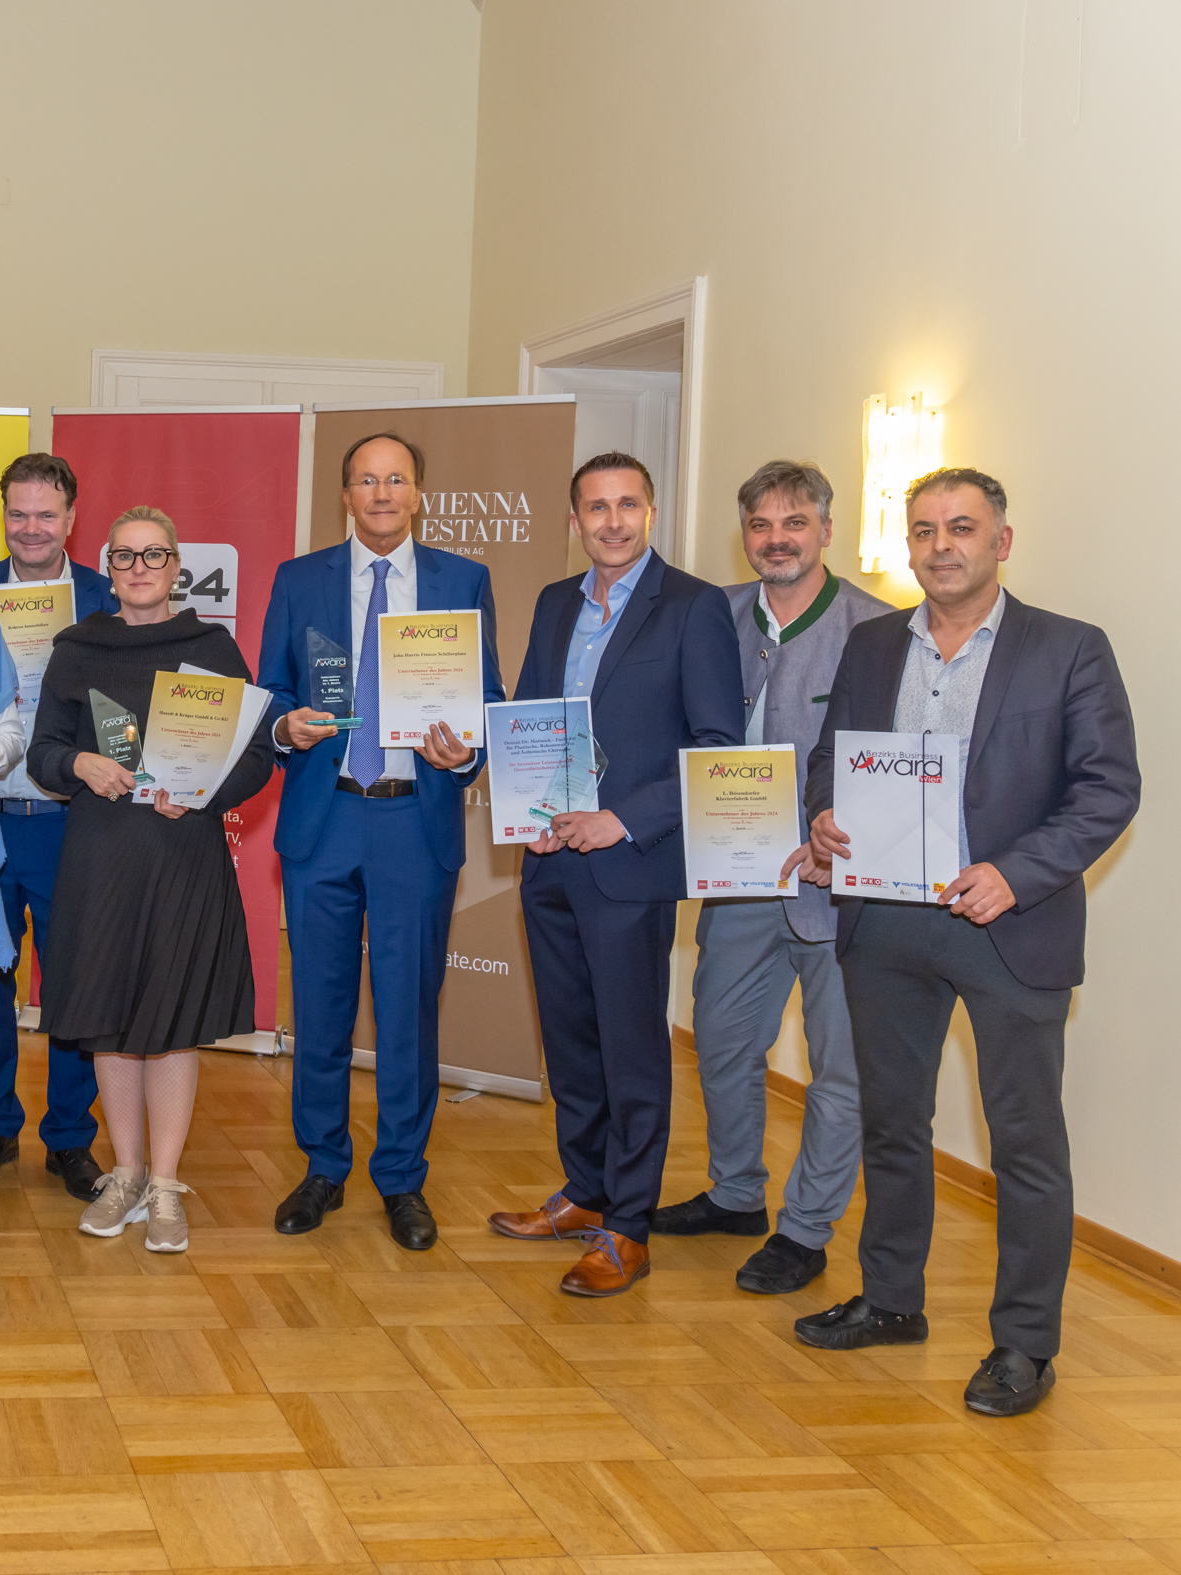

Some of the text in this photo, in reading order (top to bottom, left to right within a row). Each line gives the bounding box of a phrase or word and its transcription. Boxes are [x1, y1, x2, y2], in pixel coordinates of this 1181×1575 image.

[421, 492, 532, 515] VIENNA
[420, 518, 530, 542] ESTATE
[1, 596, 53, 613] Award
[401, 624, 457, 639] Award
[171, 684, 224, 701] Award
[511, 717, 566, 733] Award
[852, 750, 942, 776] Award
[866, 750, 938, 760] Bezirks Business
[710, 763, 772, 778] Award
